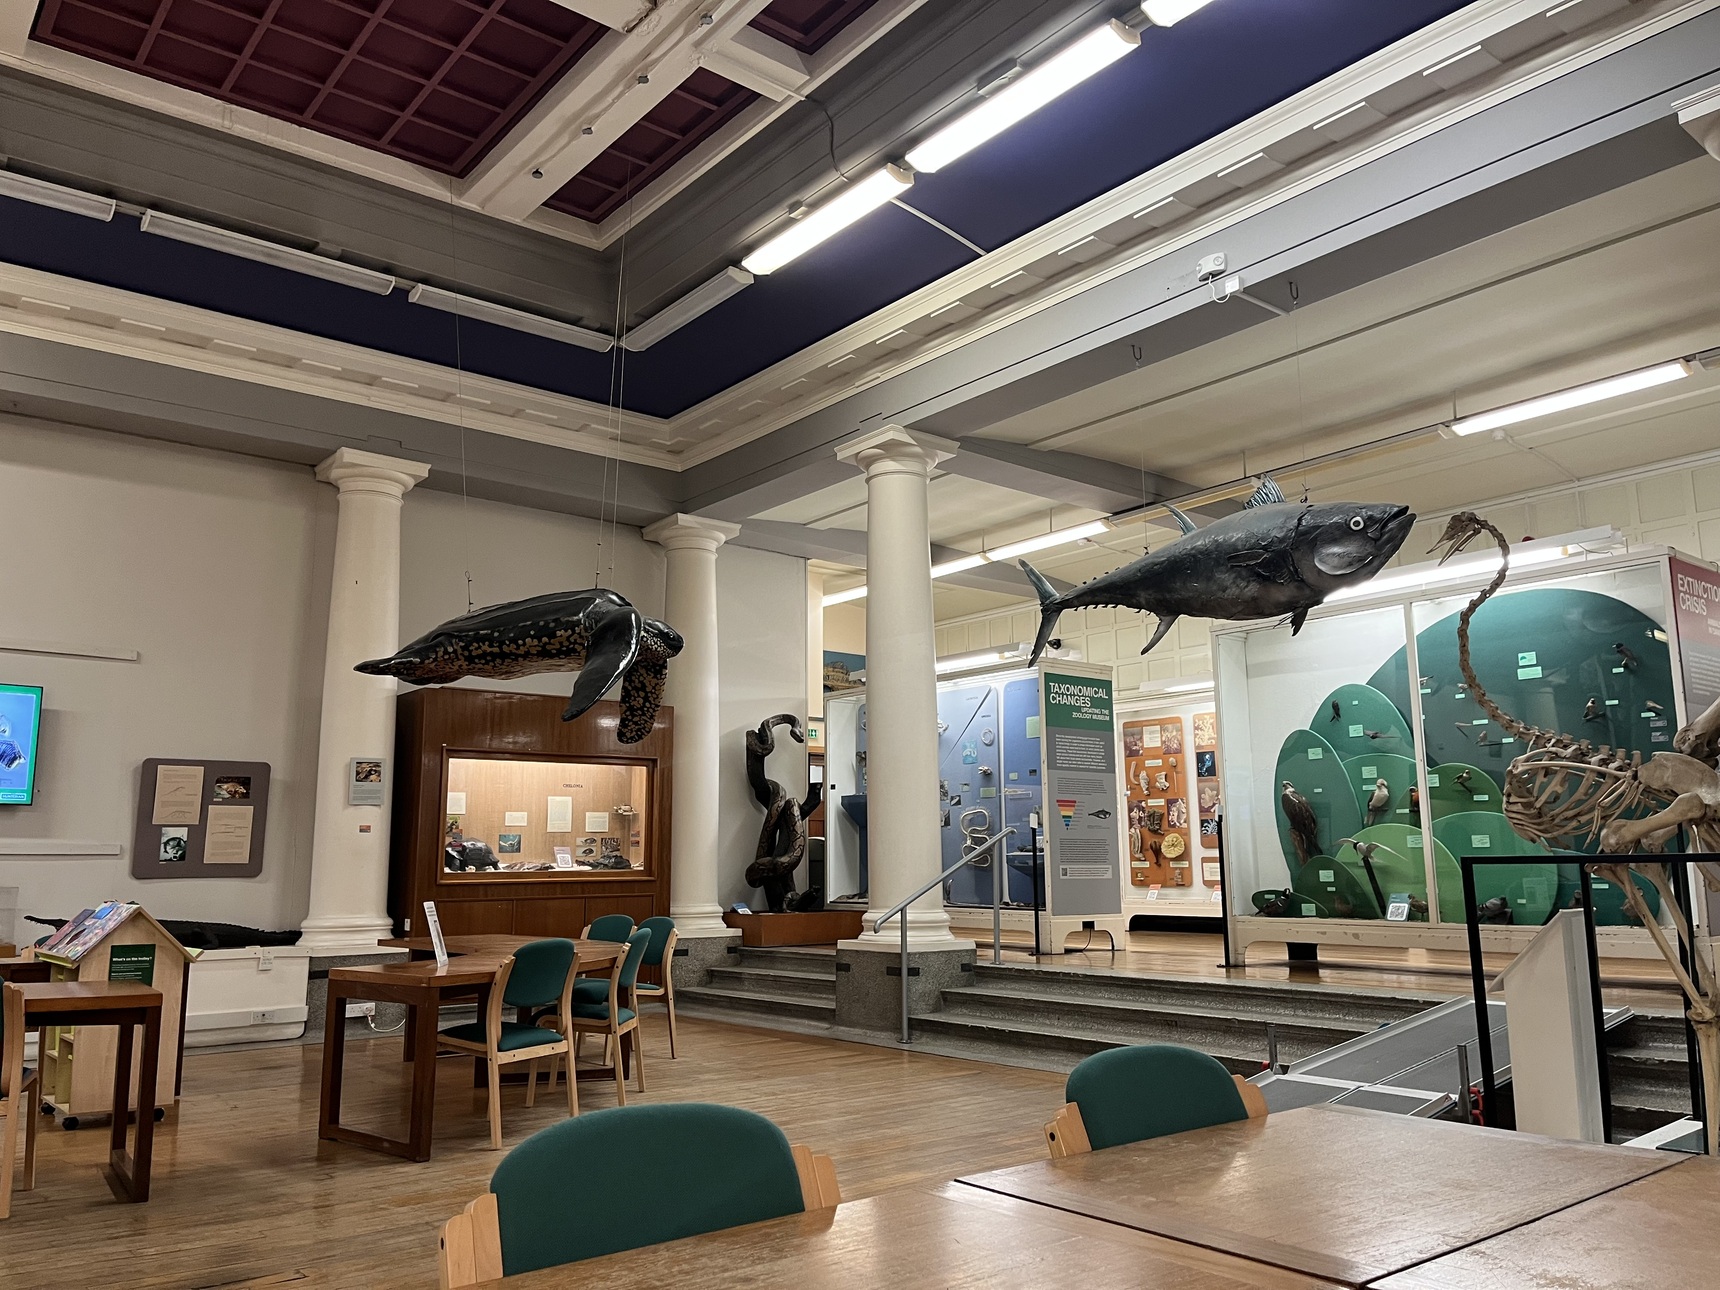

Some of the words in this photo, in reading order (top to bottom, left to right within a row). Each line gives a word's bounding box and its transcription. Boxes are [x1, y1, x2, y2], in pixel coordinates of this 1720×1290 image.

[1678, 574, 1720, 602] EXTINCTIO
[1680, 592, 1707, 616] CRISIS
[1049, 682, 1108, 699] TAXONOMICAL
[1050, 694, 1091, 707] CHANGES
